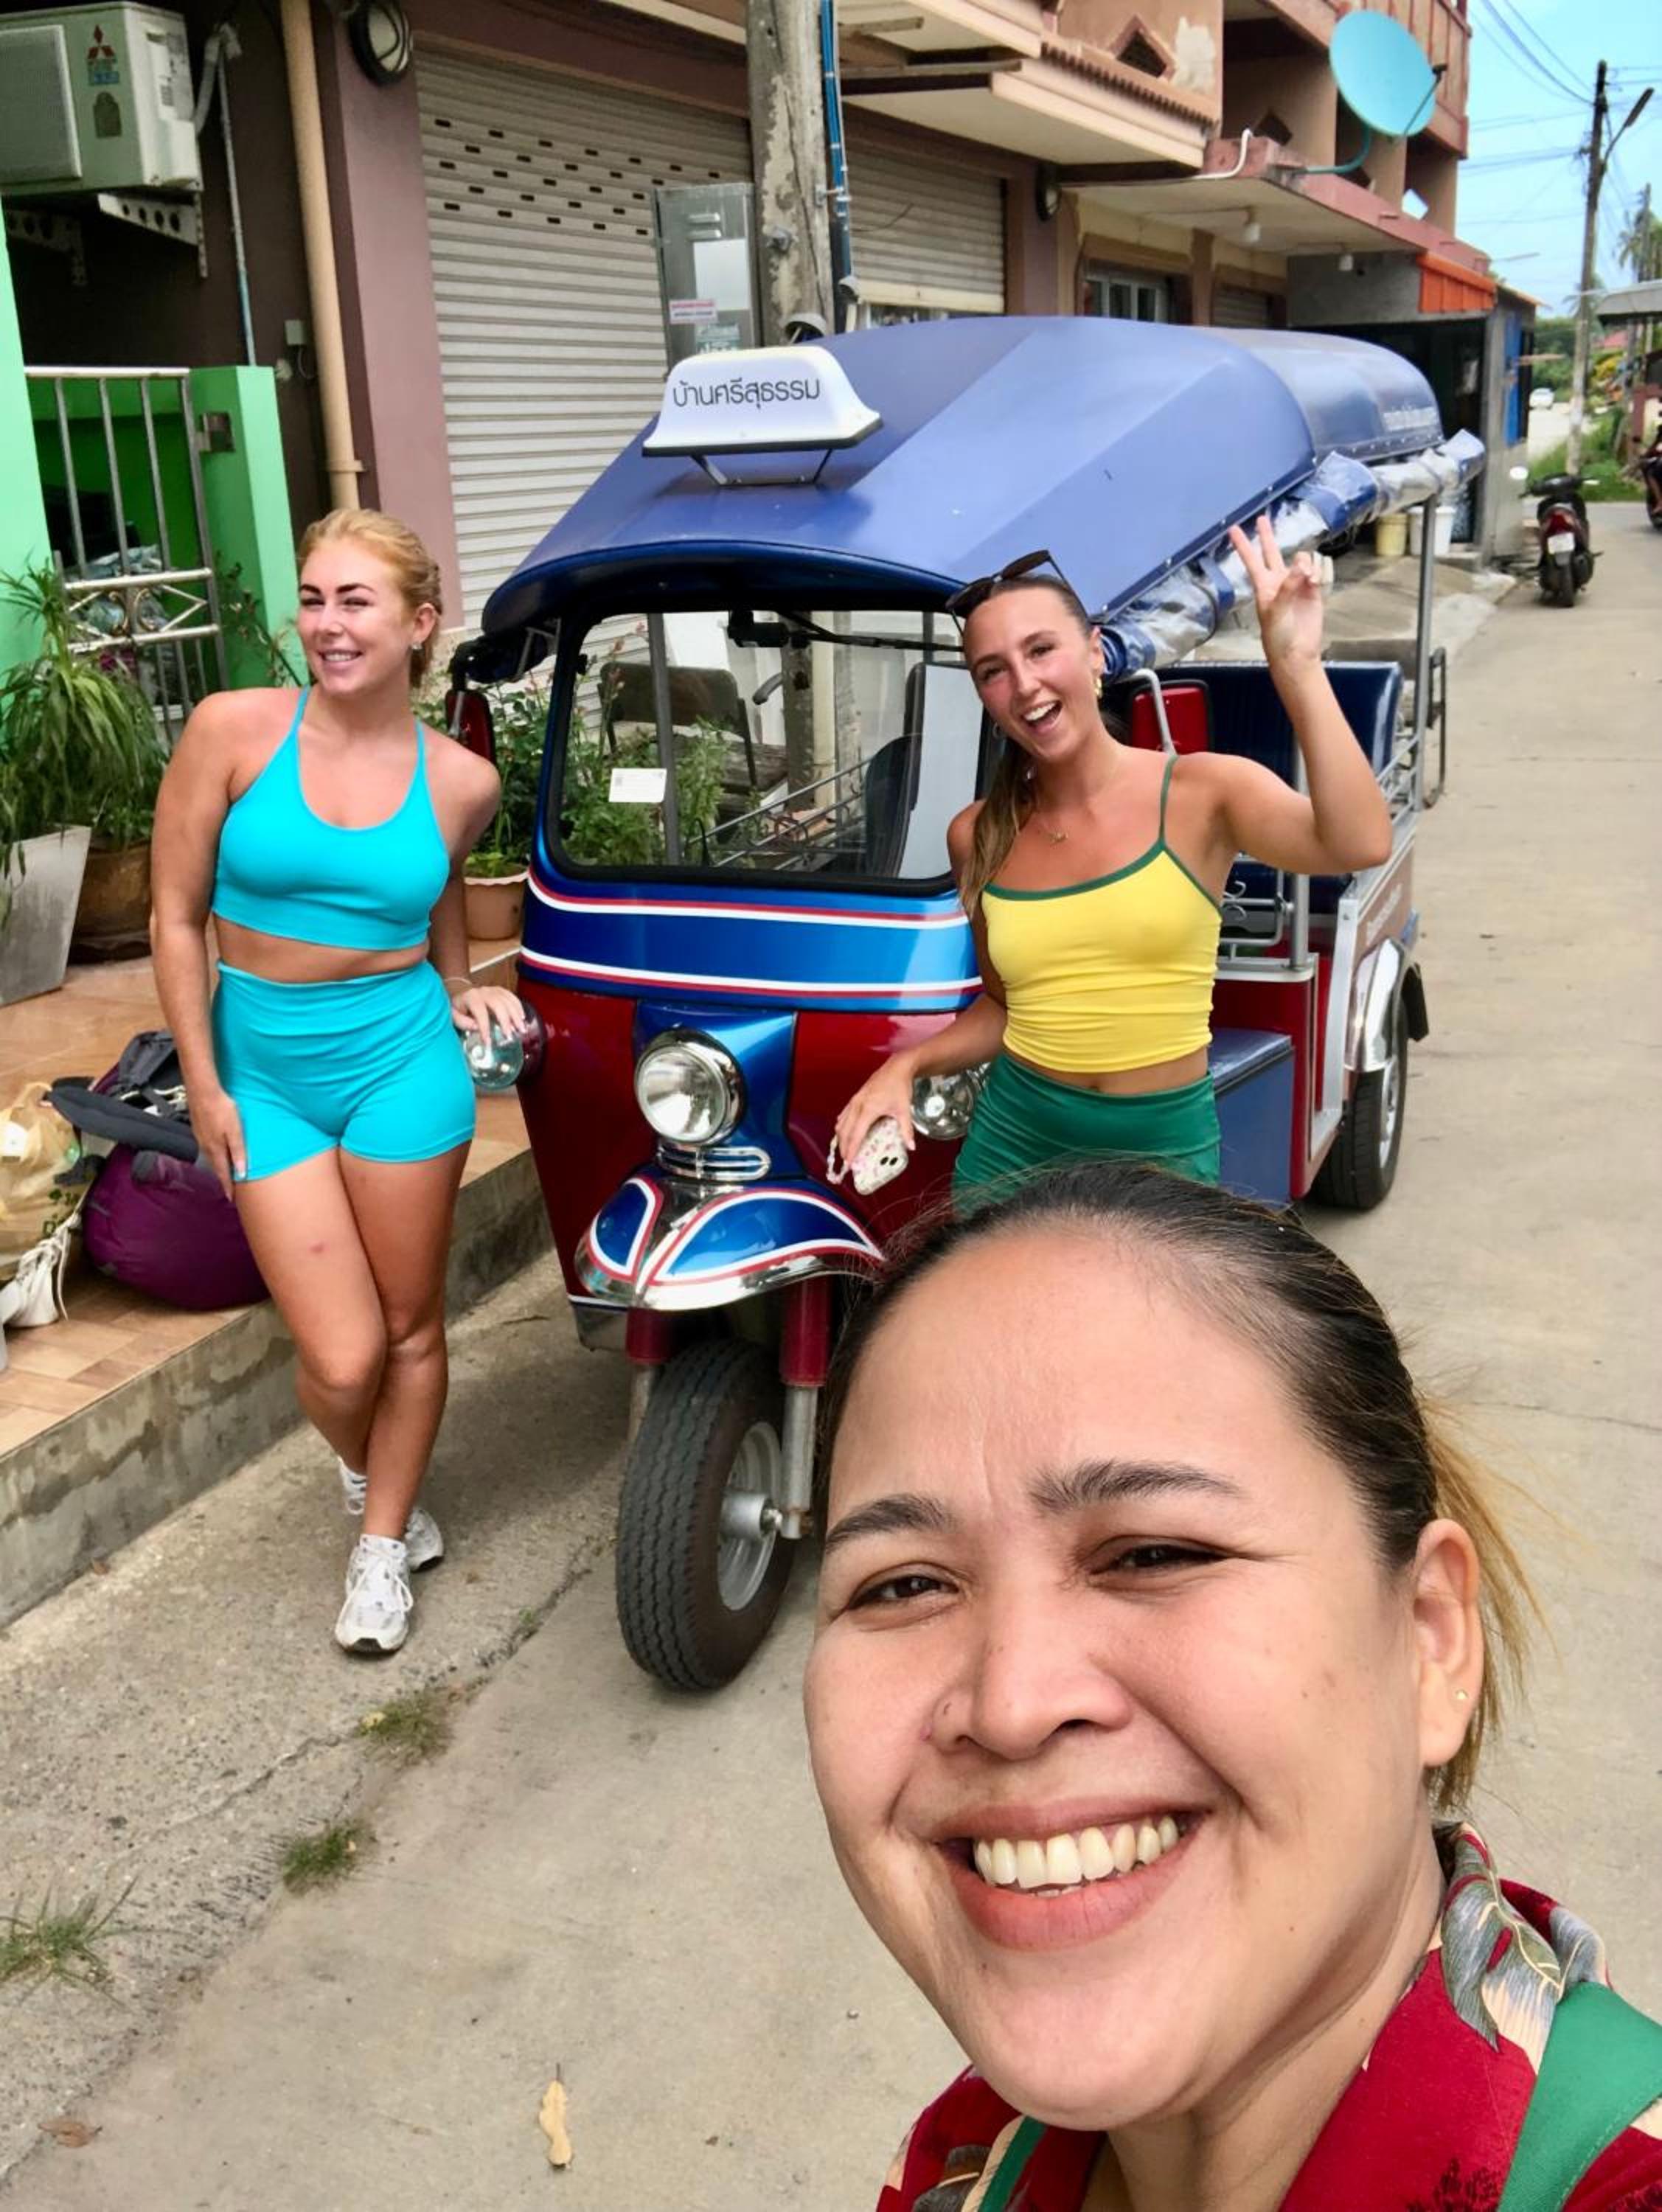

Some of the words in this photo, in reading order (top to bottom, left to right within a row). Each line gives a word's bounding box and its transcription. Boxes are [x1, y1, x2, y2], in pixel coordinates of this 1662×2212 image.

[673, 378, 820, 409] บ้านศรีสุธรรม
